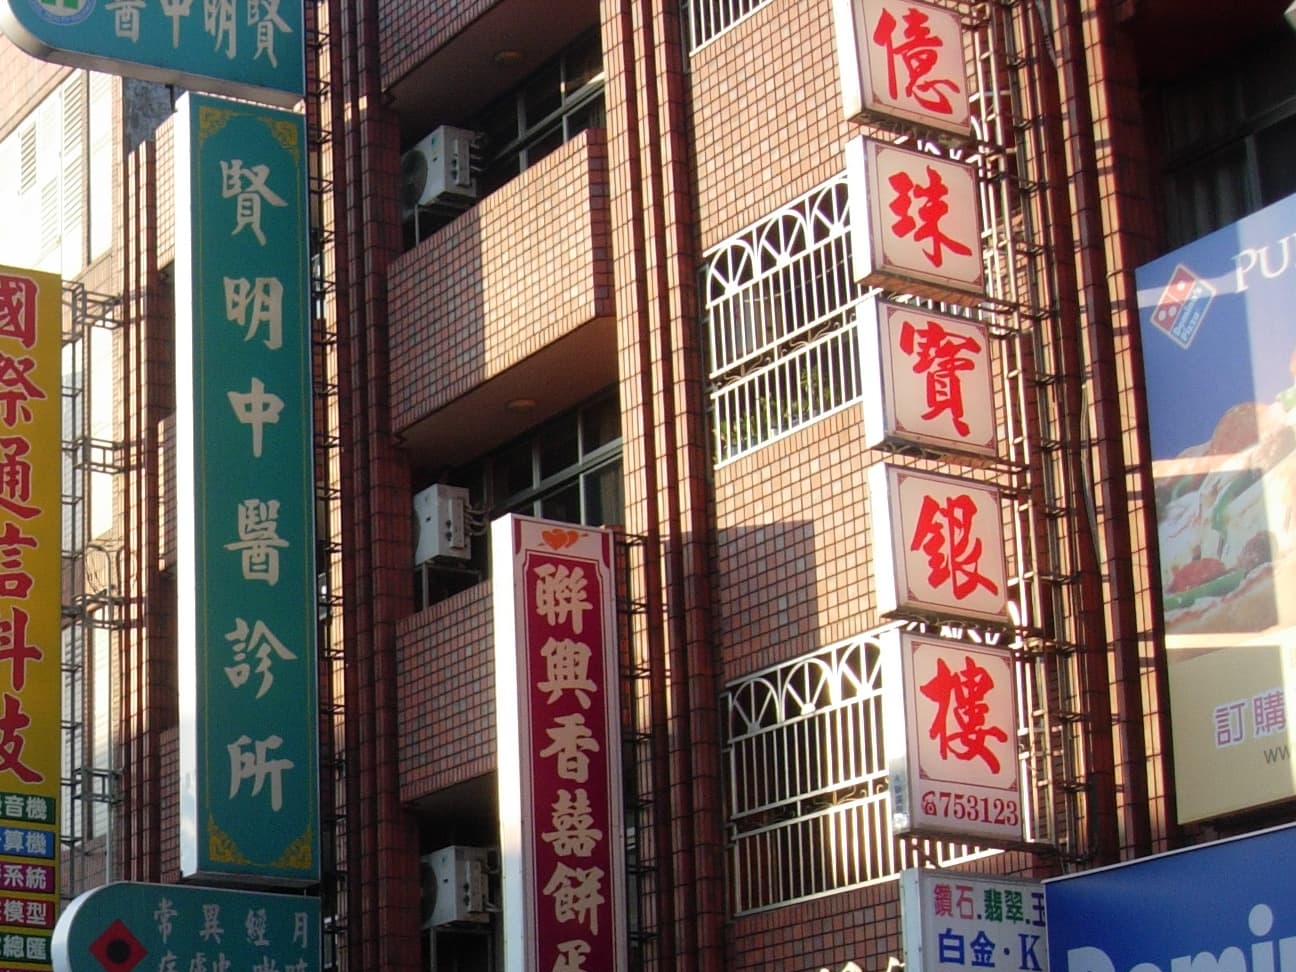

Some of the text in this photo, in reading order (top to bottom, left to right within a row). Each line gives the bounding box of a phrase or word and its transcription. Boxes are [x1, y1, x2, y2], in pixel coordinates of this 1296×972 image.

[1231, 233, 1296, 294] PU
[220, 159, 298, 812] 賢明中醫診所
[941, 794, 1019, 828] 753123
